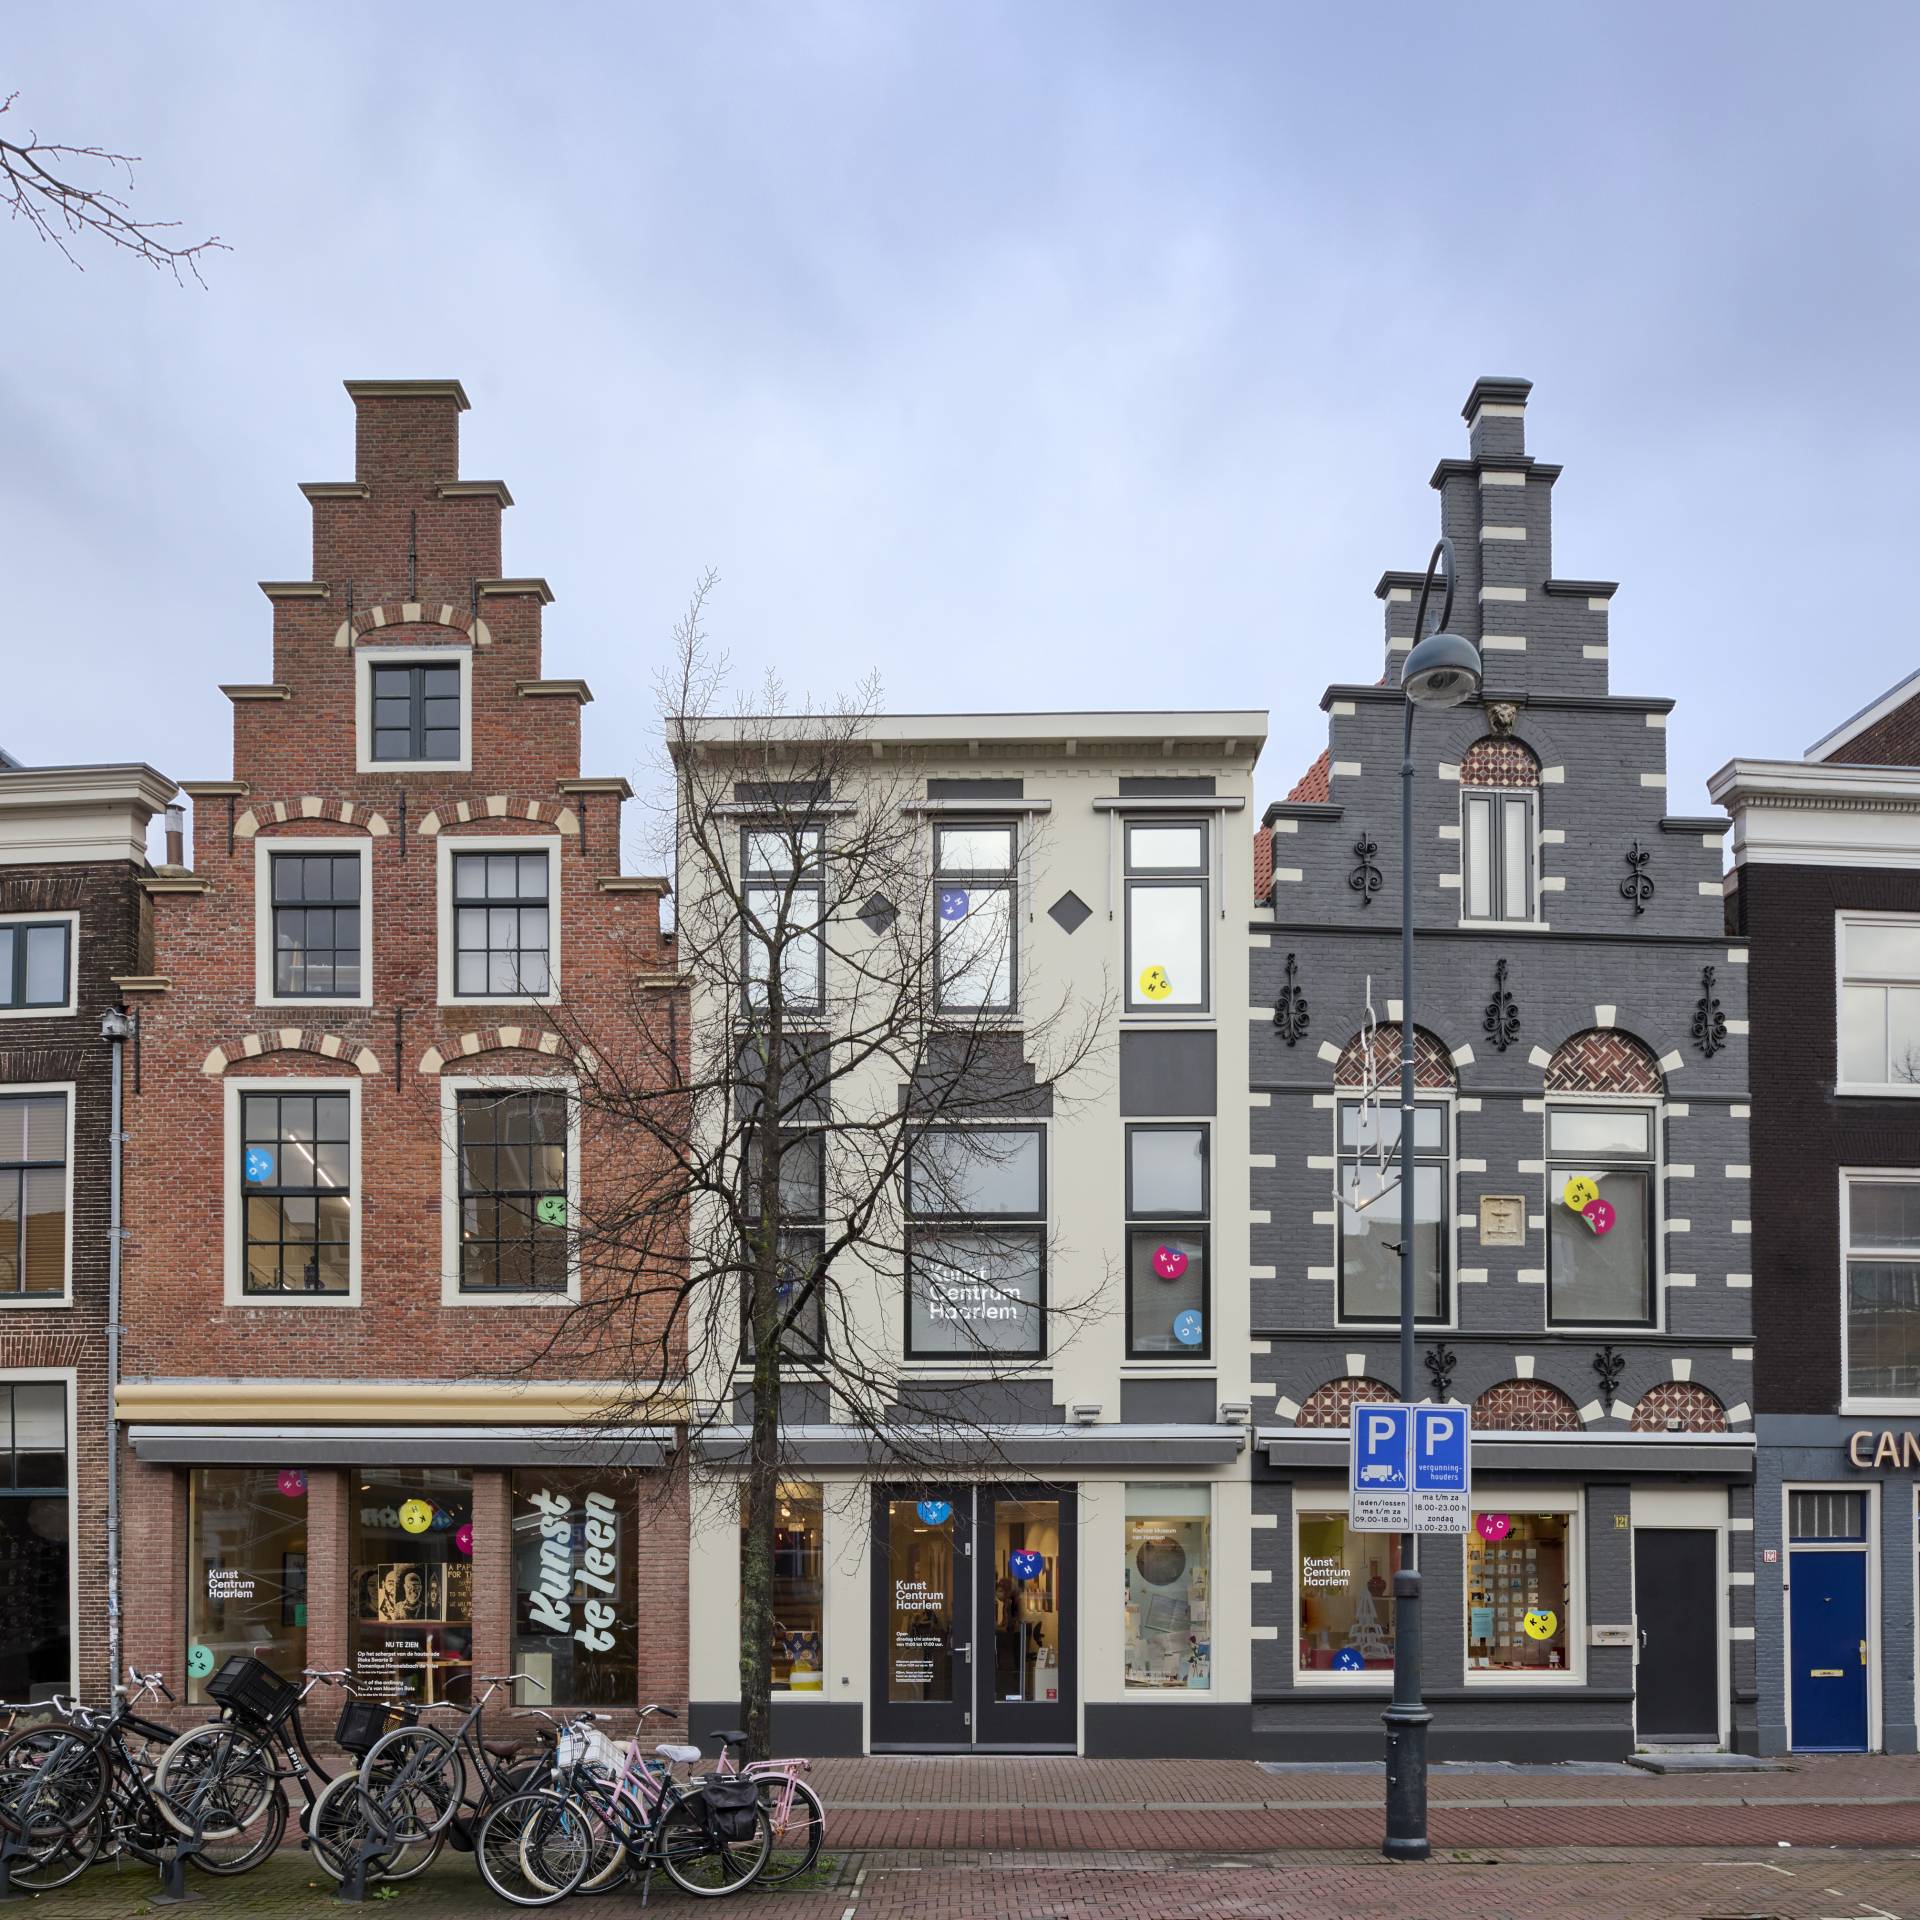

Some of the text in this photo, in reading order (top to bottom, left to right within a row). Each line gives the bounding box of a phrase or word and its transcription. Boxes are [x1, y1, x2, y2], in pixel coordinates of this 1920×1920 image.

[930, 1282, 1020, 1300] Centrum
[930, 1302, 1017, 1319] Haarlem
[1368, 1416, 1396, 1454] P
[1426, 1416, 1454, 1456] P
[1851, 1431, 1920, 1467] CAN
[1418, 1464, 1462, 1474] vergunning-
[1415, 1504, 1466, 1512] 18.00-23.00 h
[1415, 1524, 1466, 1532] 13.00-23.00 h
[529, 1488, 571, 1633] Kunst
[1304, 1557, 1334, 1566] Kunst
[208, 1570, 238, 1578] Kunst
[574, 1492, 616, 1652] te leen
[1304, 1567, 1351, 1577] Centrum
[208, 1579, 254, 1588] Centrum
[896, 1580, 927, 1590] Kunst
[1304, 1577, 1348, 1586] Haarlem
[208, 1589, 253, 1598] Haarlem
[896, 1590, 944, 1600] Centrum
[896, 1600, 942, 1610] Haarlem
[286, 1746, 306, 1780] SPIRT
